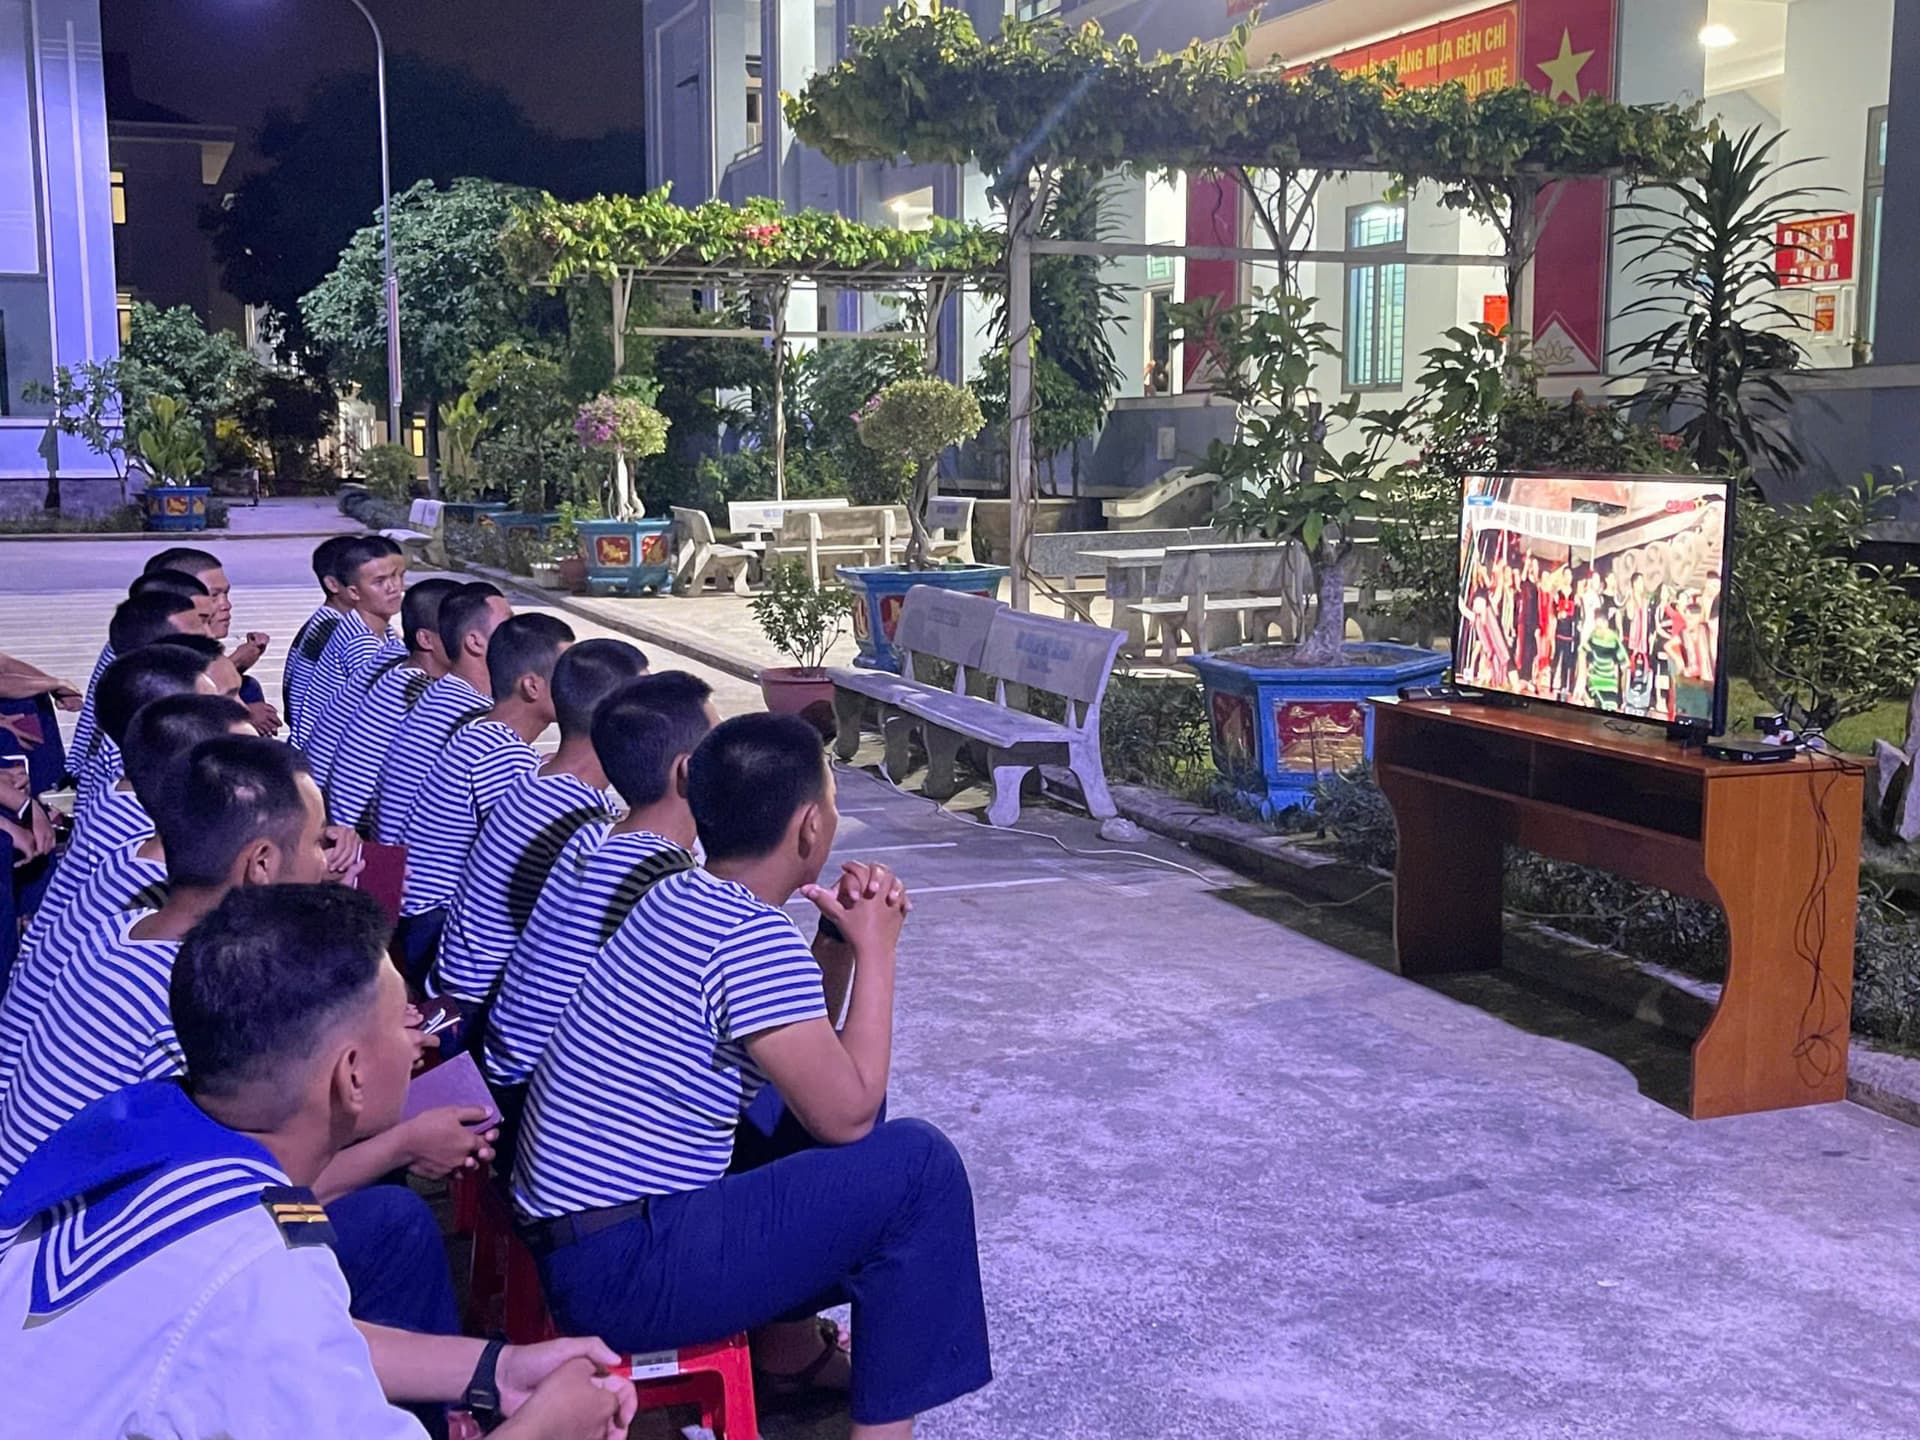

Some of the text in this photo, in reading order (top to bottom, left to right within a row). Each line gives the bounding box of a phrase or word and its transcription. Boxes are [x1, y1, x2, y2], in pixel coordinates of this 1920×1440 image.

[1456, 29, 1481, 59] RÈN
[1485, 18, 1507, 50] CHÍ
[1485, 56, 1507, 91] TRẺ
